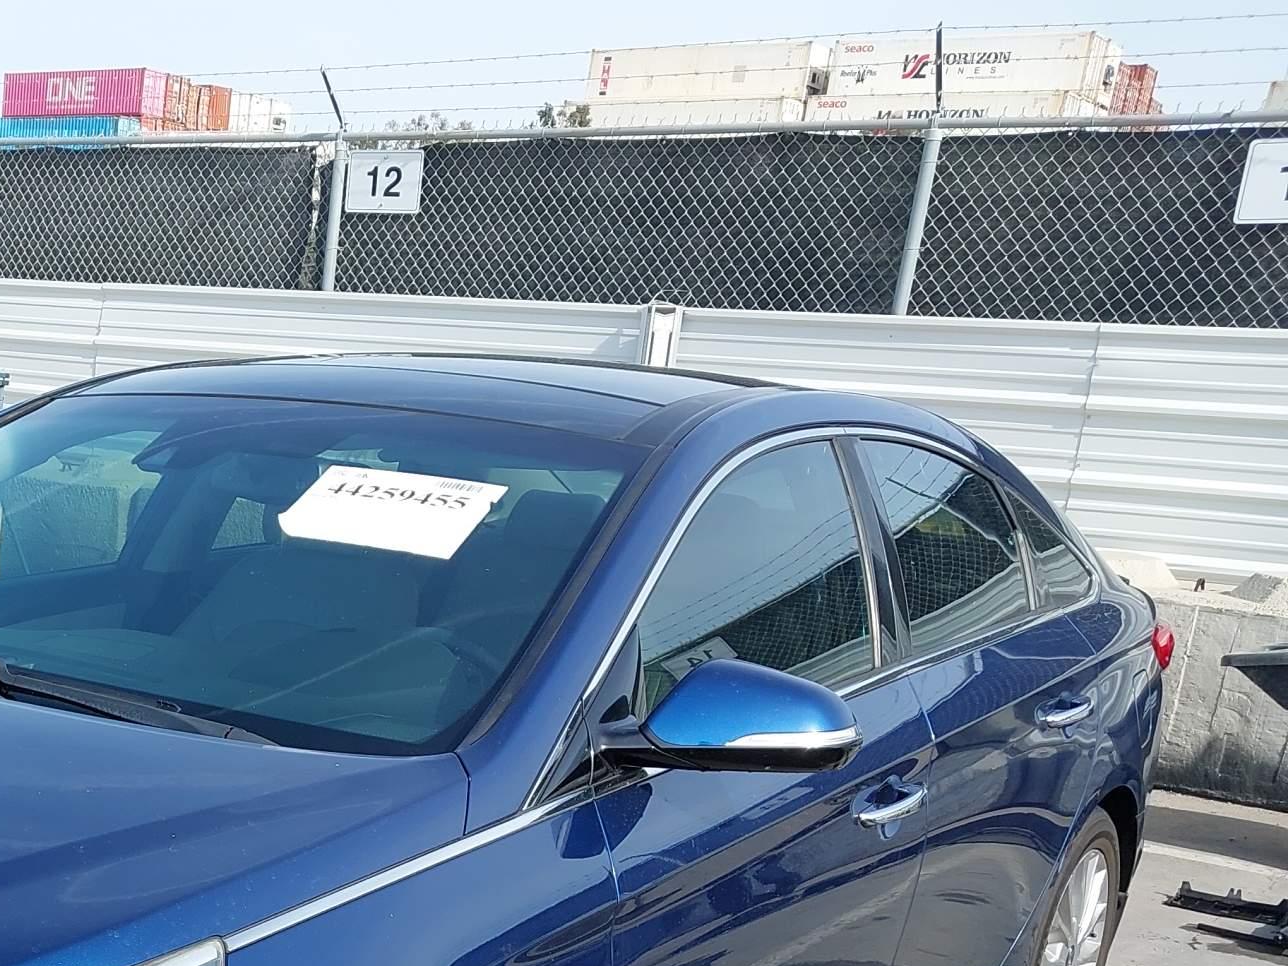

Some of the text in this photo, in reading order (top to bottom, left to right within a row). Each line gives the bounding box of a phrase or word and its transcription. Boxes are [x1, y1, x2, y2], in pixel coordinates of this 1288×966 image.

[844, 44, 874, 53] seaco
[46, 76, 95, 101] ONE
[817, 99, 847, 109] seaco
[367, 165, 403, 197] 12
[327, 482, 471, 509] 44259455
